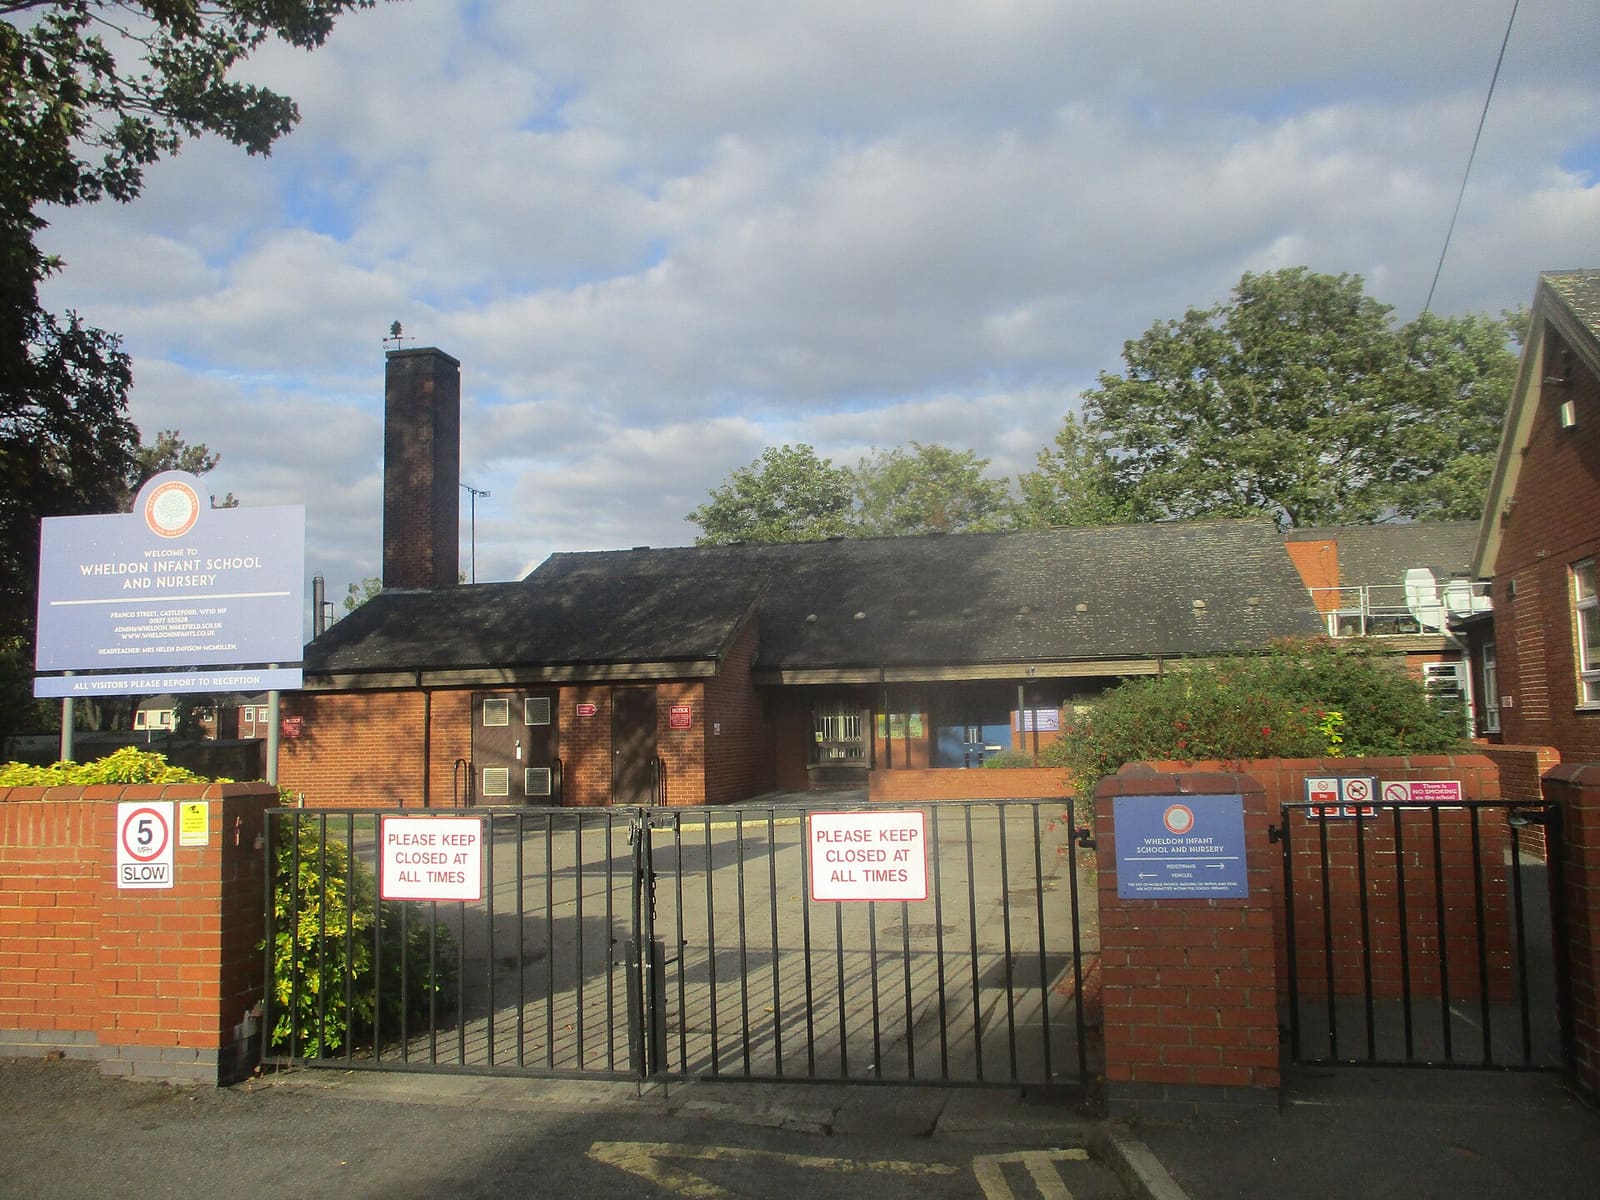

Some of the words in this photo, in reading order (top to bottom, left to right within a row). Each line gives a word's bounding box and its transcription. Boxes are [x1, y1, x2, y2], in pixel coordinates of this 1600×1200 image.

[144, 550, 184, 558] WELCOME
[80, 562, 148, 576] WHELDON
[154, 560, 200, 572] INFANT
[206, 556, 262, 570] SCHOOL
[123, 578, 151, 590] AND
[156, 574, 216, 588] NURSERY
[74, 682, 88, 690] ALL
[91, 680, 128, 689] VISITORS
[130, 680, 160, 688] PLEASE
[163, 678, 196, 687] REPORT
[198, 678, 210, 686] TO
[213, 676, 260, 685] RECEPTION
[137, 819, 152, 845] 5
[817, 830, 872, 842] PLEASE
[880, 829, 918, 842] KEEP
[388, 834, 436, 846] PLEASE
[442, 834, 476, 846] KEEP
[395, 852, 448, 864] CLOSED
[453, 853, 468, 864] AT
[826, 849, 886, 862] CLOSED
[893, 849, 910, 862] AT
[124, 866, 165, 880] SLOW
[398, 870, 421, 882] ALL
[426, 871, 465, 883] TIMES
[830, 870, 856, 882] ALL
[862, 869, 908, 882] TIMES
